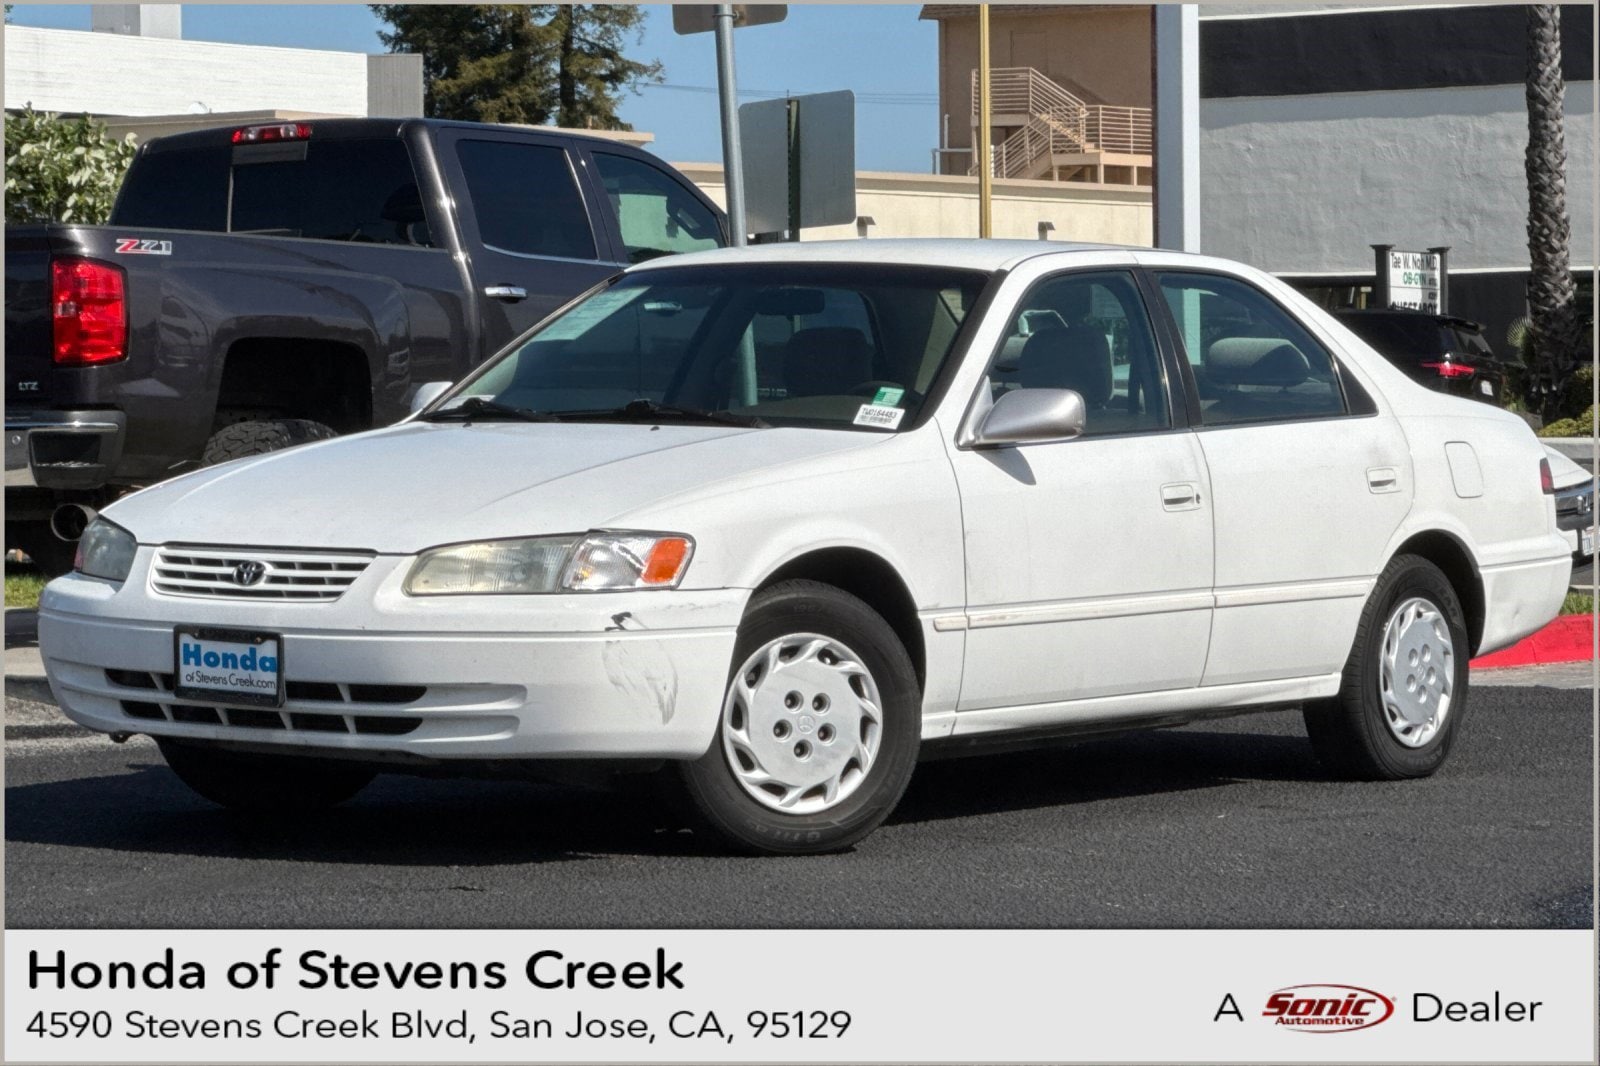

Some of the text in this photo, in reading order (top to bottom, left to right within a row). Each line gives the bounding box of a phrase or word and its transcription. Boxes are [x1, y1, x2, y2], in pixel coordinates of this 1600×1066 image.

[115, 238, 172, 255] Z71
[1403, 272, 1427, 286] OB-GYN
[183, 643, 277, 672] Honda
